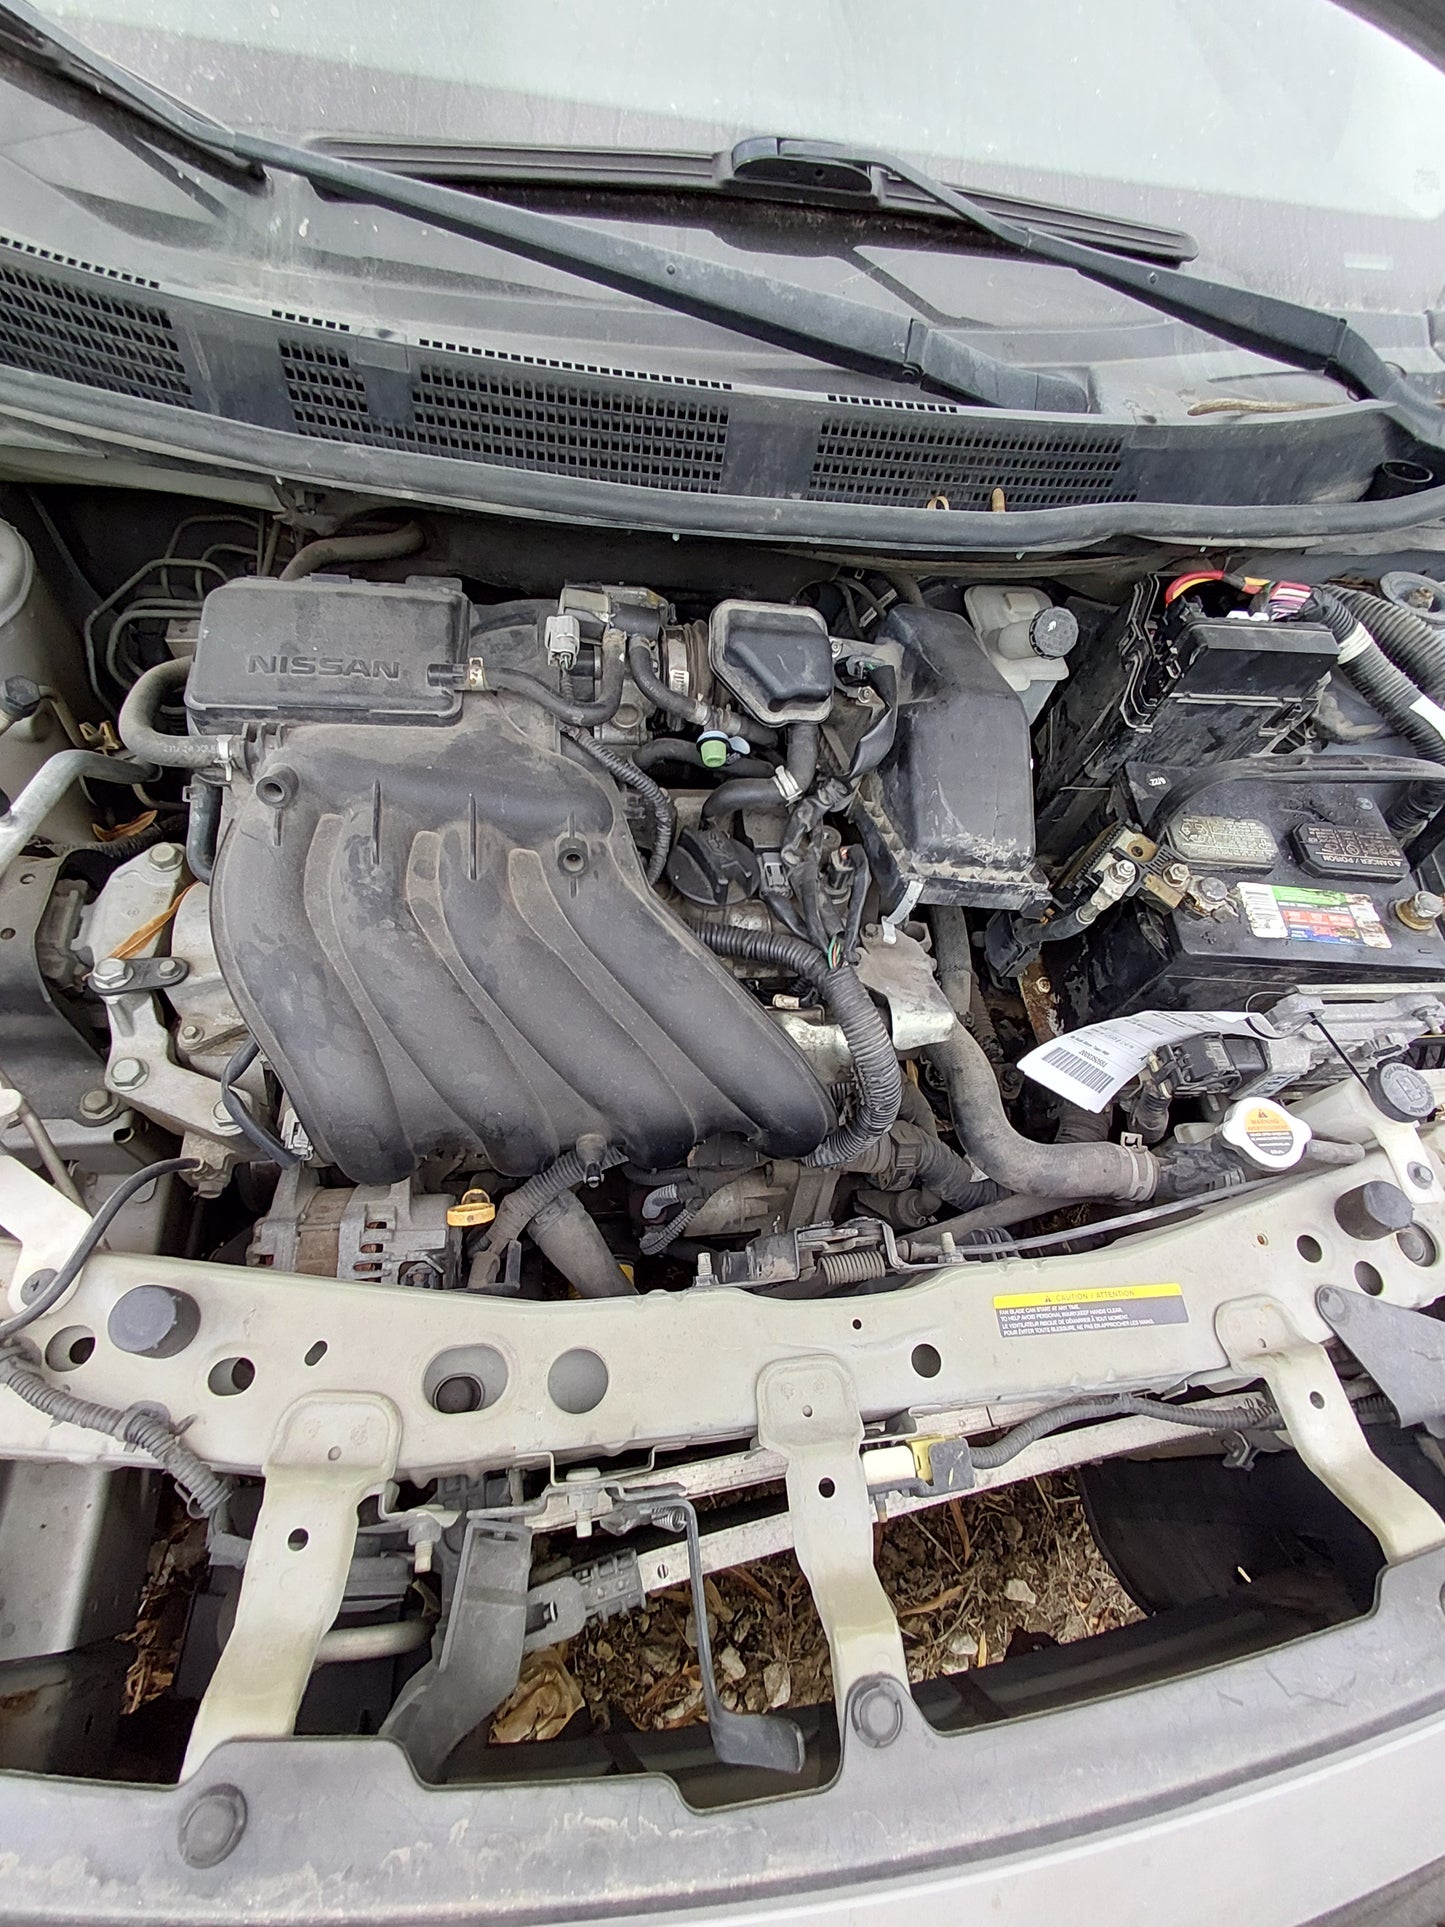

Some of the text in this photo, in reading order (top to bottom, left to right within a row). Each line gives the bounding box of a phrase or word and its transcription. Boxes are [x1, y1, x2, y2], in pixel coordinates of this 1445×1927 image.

[248, 655, 400, 680] NISSAN
[1322, 855, 1354, 864] POISON
[1360, 857, 1394, 867] DANGER
[1055, 1293, 1089, 1303] CAUTION
[1096, 1290, 1135, 1299] ATTENTION
